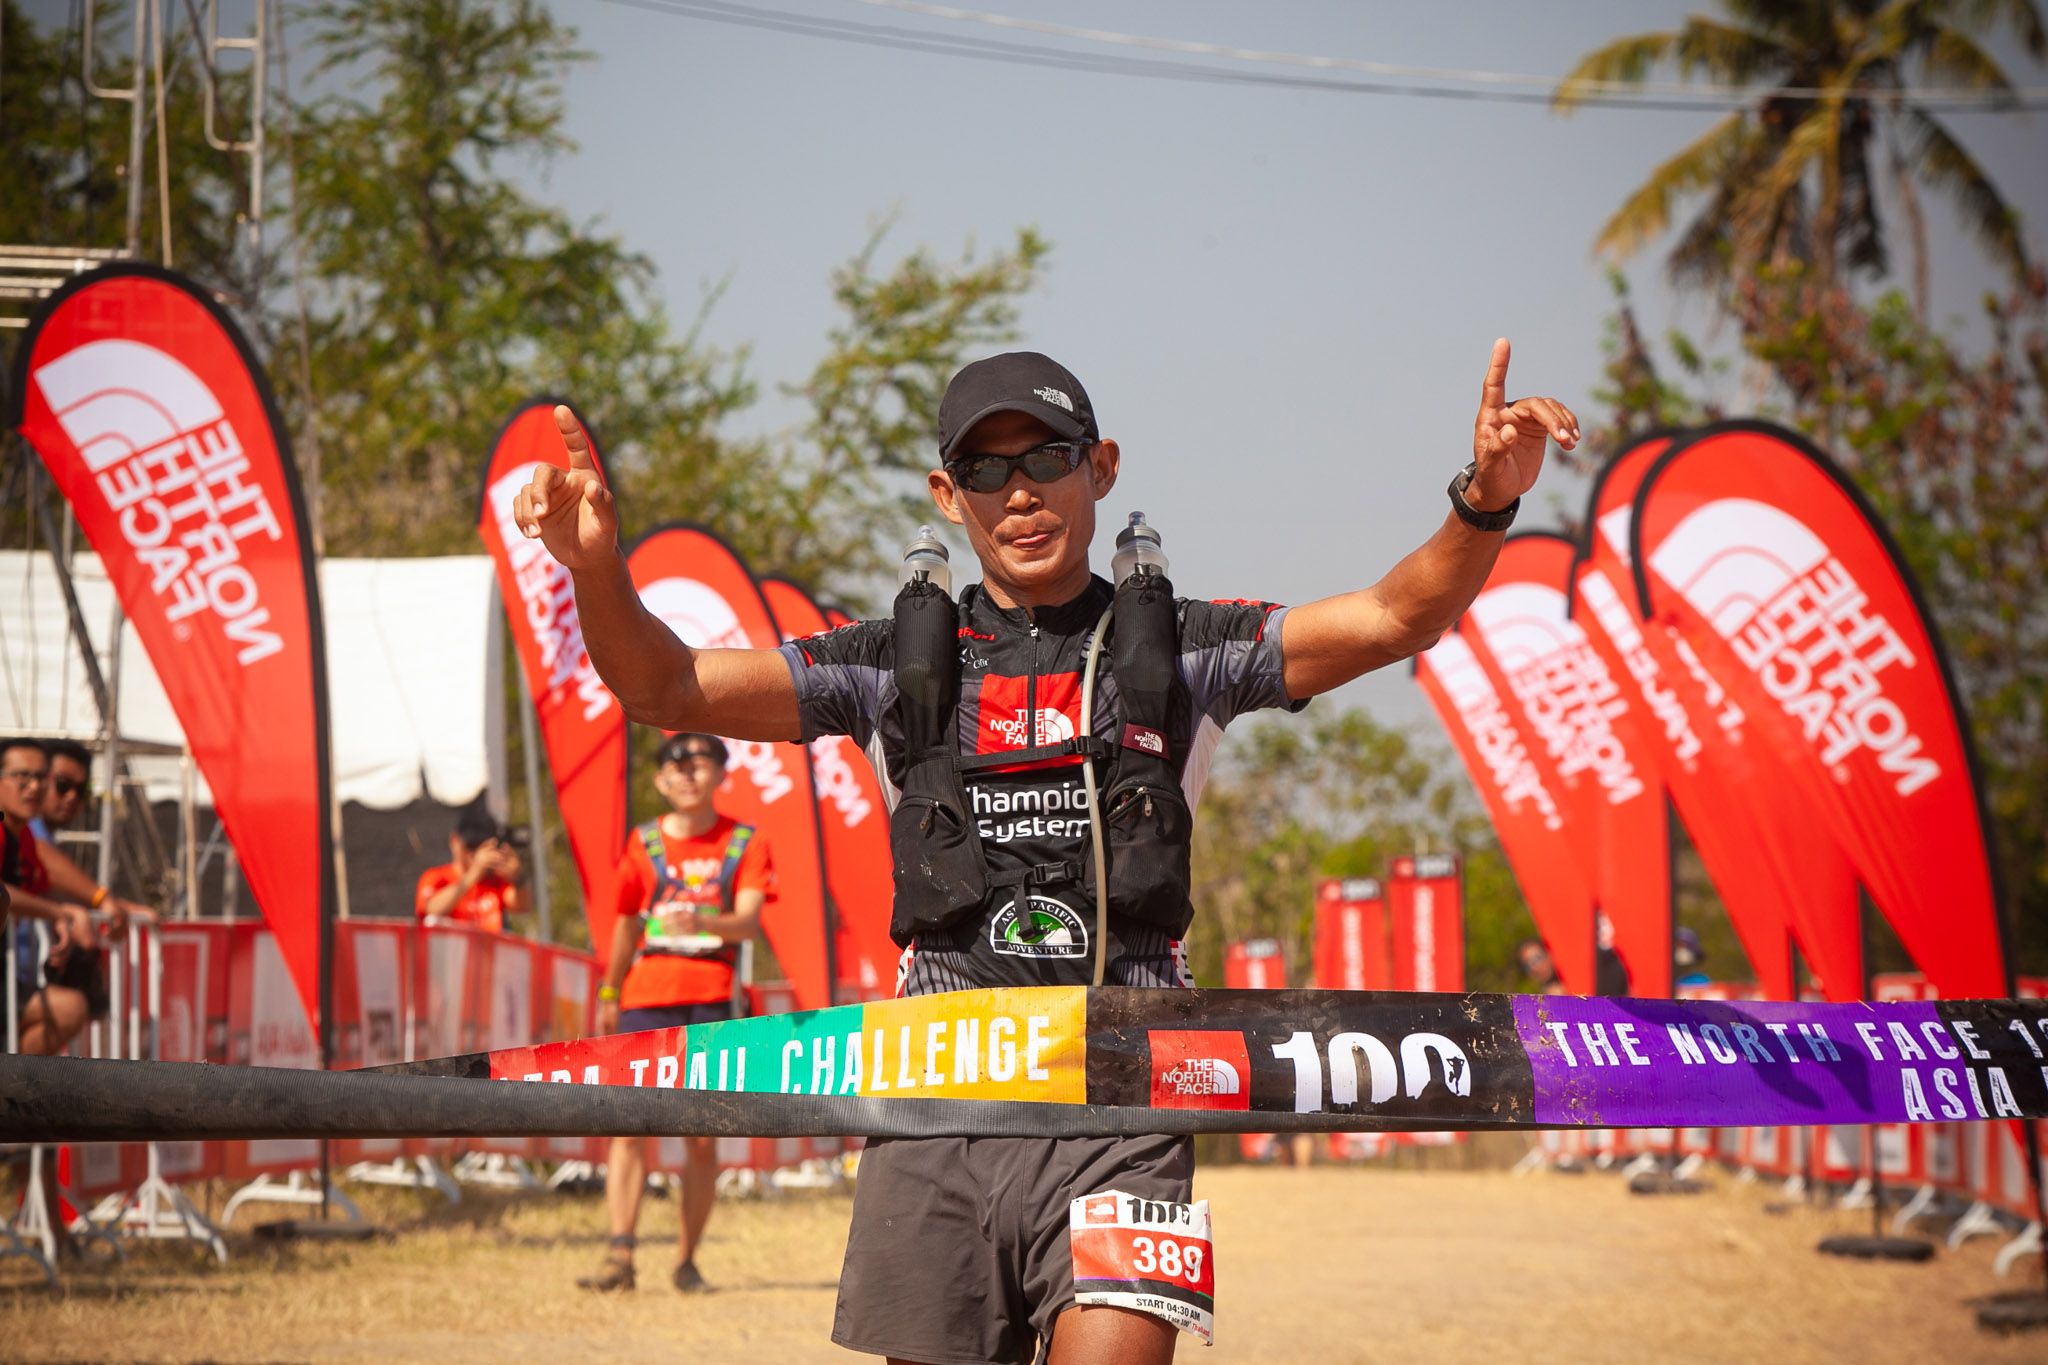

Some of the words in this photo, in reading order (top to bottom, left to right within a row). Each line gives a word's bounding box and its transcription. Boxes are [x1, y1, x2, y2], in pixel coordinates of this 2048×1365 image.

[990, 719, 1045, 734] NORH
[966, 782, 1093, 816] hampio
[1030, 901, 1078, 929] PACIFIC
[1006, 943, 1073, 955] ADVENTURE
[780, 1015, 1050, 1099] CHALLENGE
[1545, 1022, 1652, 1068] THE
[1665, 1022, 1842, 1065] NORTH
[1854, 1020, 1992, 1062] FACE
[1161, 1071, 1213, 1084] NORTH
[1183, 1058, 1213, 1072] THE
[1271, 1031, 1472, 1114] 100
[1175, 1082, 1213, 1095] FACE
[1900, 1065, 2025, 1122] ASIA
[1132, 1236, 1203, 1284] 389
[1135, 1297, 1165, 1310] START
[1166, 1302, 1190, 1317] 04:30
[1190, 1309, 1201, 1322] AM
